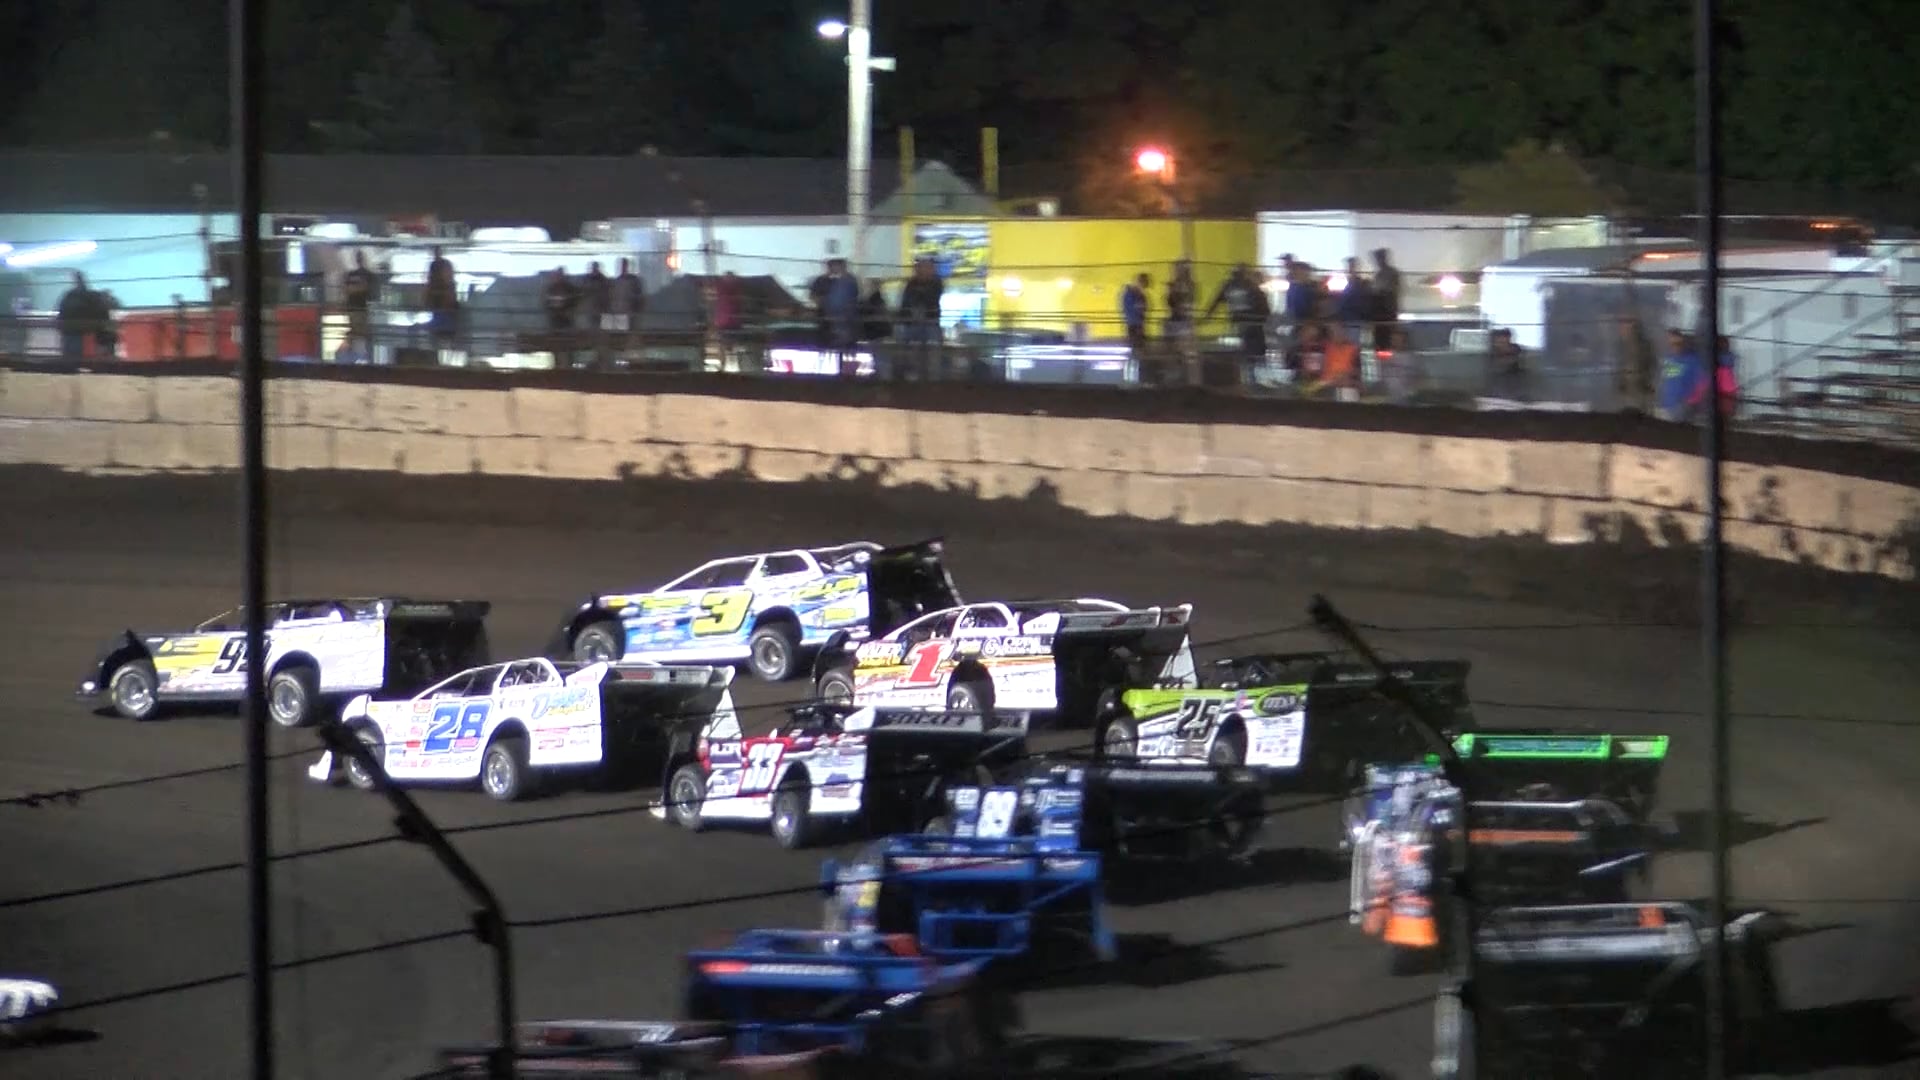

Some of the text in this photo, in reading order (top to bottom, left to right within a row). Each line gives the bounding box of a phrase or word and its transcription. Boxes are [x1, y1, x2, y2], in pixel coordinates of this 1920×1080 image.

[692, 589, 754, 637] 3
[897, 641, 948, 685] 1
[423, 701, 492, 753] 28
[741, 743, 784, 791] 33
